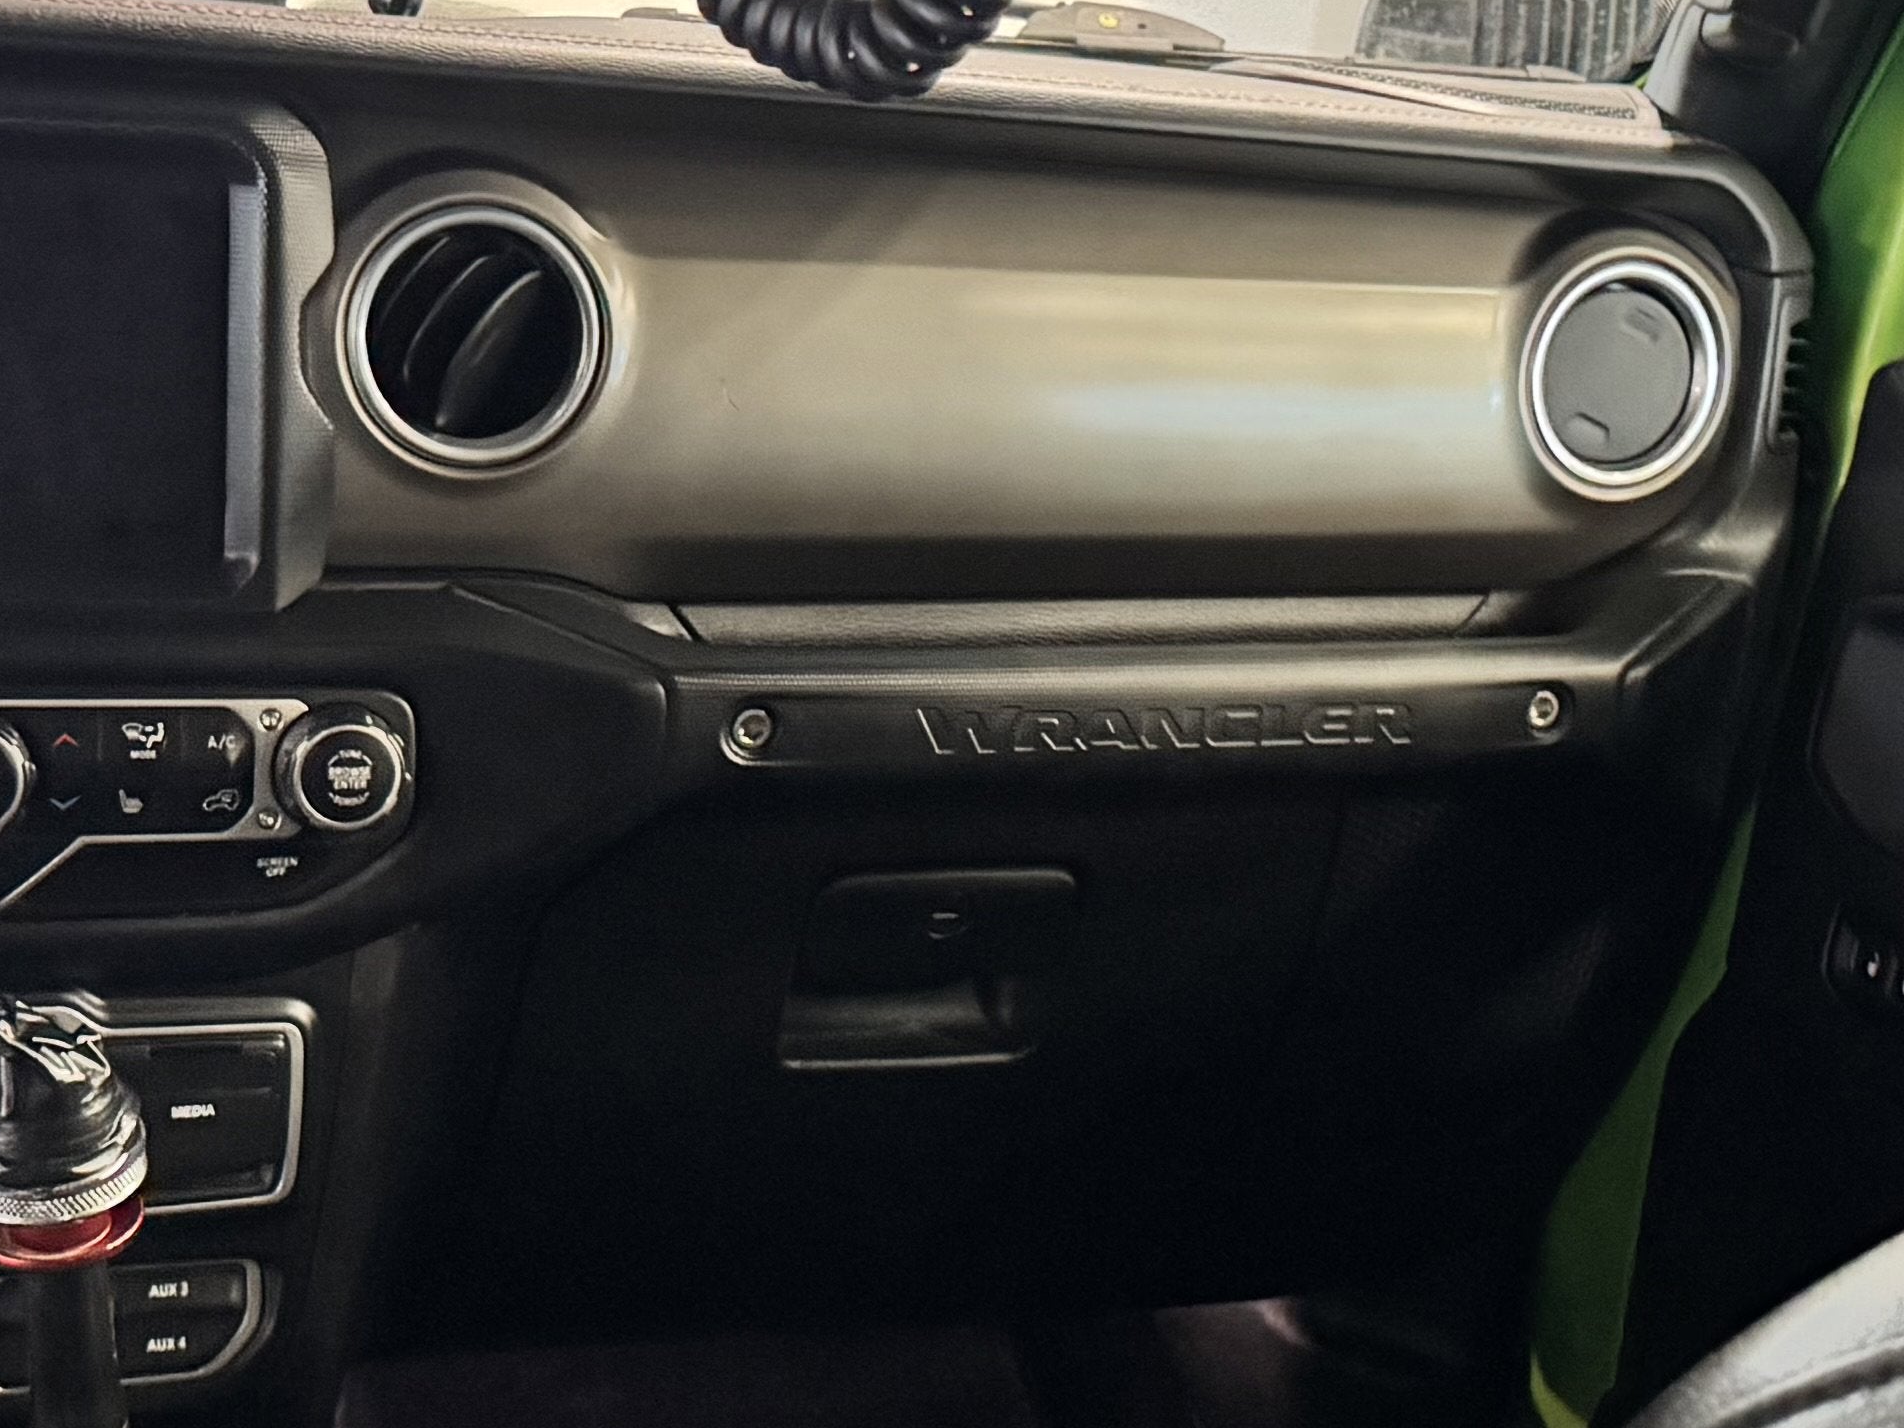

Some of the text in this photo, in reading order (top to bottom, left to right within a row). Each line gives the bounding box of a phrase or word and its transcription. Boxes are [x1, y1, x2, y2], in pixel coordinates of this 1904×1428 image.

[916, 702, 1414, 755] WRANGLER
[207, 734, 236, 750] A/C
[171, 1103, 216, 1120] MEDIA
[148, 1280, 190, 1299] AUX 3
[147, 1336, 187, 1353] AUX 4
